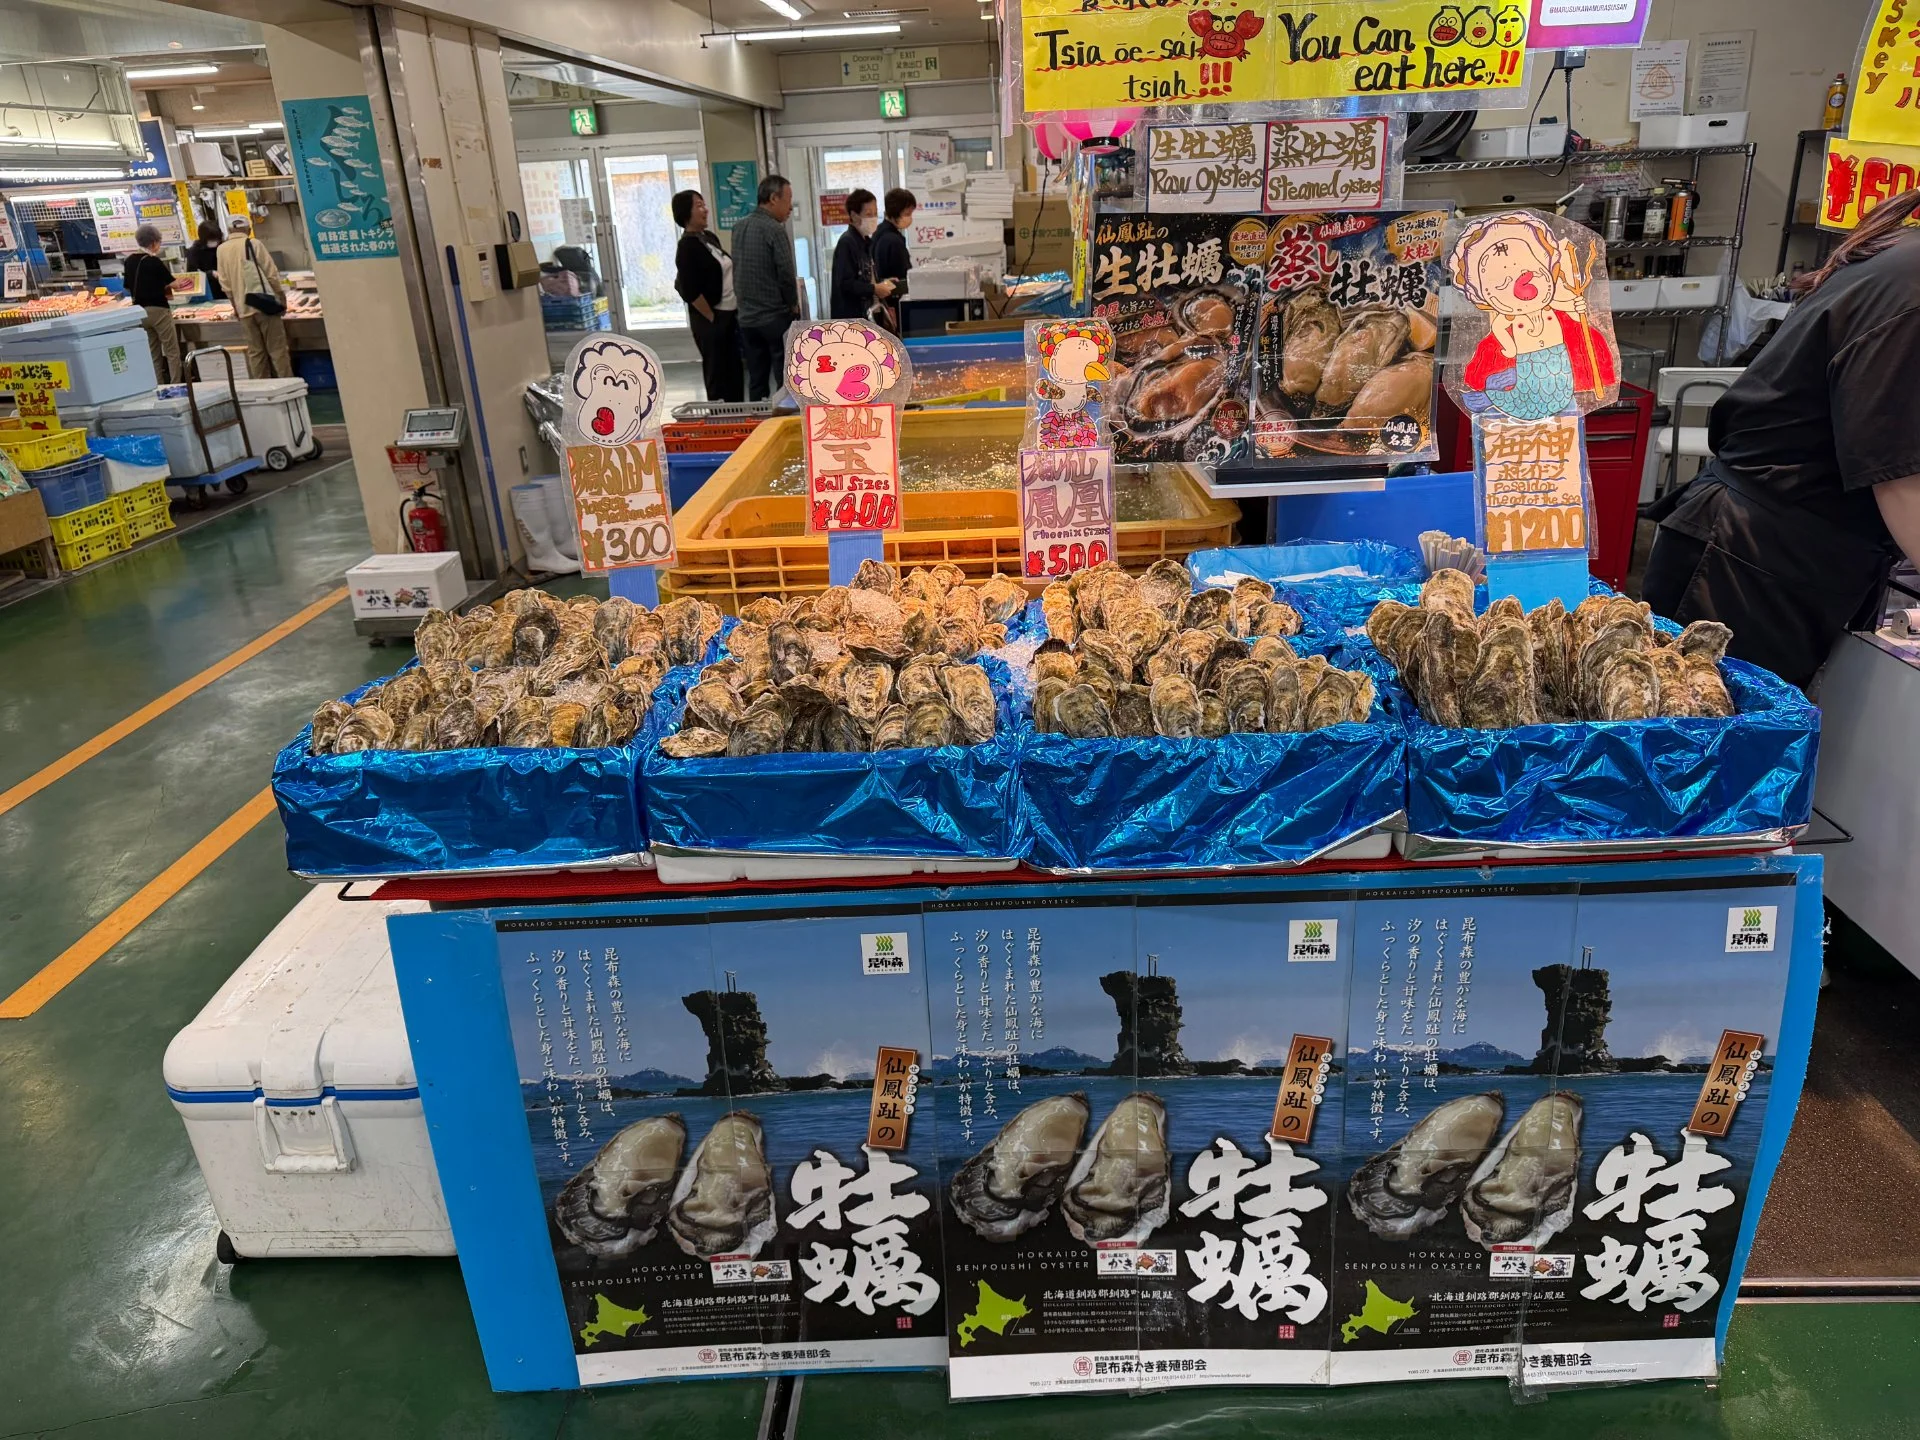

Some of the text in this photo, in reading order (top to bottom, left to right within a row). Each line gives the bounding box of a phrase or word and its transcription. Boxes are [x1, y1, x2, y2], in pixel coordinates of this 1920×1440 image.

[1034, 29, 1106, 70] Tsia
[1278, 13, 1416, 62] You Can
[900, 51, 916, 59] EXIT
[1354, 55, 1416, 91] eat
[1152, 124, 1258, 164] 生牡蠣
[1270, 119, 1377, 170] 蒸牡蠣
[1152, 168, 1190, 196] Raw
[1269, 170, 1381, 200] Steamed oysters
[1096, 221, 1169, 245] 仙鳳趾の
[1231, 231, 1267, 242] 産地直送
[1319, 219, 1366, 238] 仙鳳趾の
[1396, 217, 1441, 233] 旨み凝縮!
[1266, 224, 1340, 291] 蒸し
[1402, 242, 1438, 260] 大粒!
[1093, 237, 1224, 301] 生牡蠣
[1329, 260, 1428, 308] 牡蠣
[1219, 420, 1240, 432] 名産
[1385, 422, 1419, 435] 仙鳳趾
[1390, 433, 1413, 447] 名産
[819, 442, 877, 476] 玉
[815, 476, 889, 492] Ball Sizes
[1494, 480, 1558, 493] Poseidon
[1561, 493, 1582, 504] Sea
[812, 492, 897, 530] ¥400
[581, 522, 671, 568] ¥300
[1033, 529, 1082, 540] Phoenix
[1486, 507, 1585, 554] ¥1200
[1027, 539, 1108, 576] ¥500
[367, 594, 391, 608] かき
[504, 920, 553, 928] HOKKAIDO
[558, 918, 610, 926] SENPOUSHI
[1293, 944, 1330, 955] 昆布森
[1731, 933, 1769, 944] 昆布森
[868, 957, 904, 968] 昆布森
[1451, 917, 1476, 1036] 昆布森の豊かな海に
[1027, 927, 1044, 1041] 昆布森の豊かな海に
[604, 947, 632, 1063] 昆布森の豊かな海に
[1001, 929, 1023, 1097] はぐくまれた仙鳳趾の牡蠣は、
[1395, 918, 1423, 1120] 汐の香りと甘味をたっぷりと含み、
[1423, 918, 1449, 1095] はぐくまれた仙鳳趾の牡蠣は、
[578, 949, 616, 1118] はぐくまれた仙鳳趾の牡蠣は、
[950, 931, 976, 1148] ふっくらとした身と味わいが特徴です。
[975, 929, 999, 1121] 汐の香りと甘味をたっぷりと含み、
[1369, 921, 1397, 1145] ふっくらとした身と味わいが特徴です。
[526, 952, 574, 1169] ふっくらとした身と味わいが特徴です。
[551, 949, 595, 1144] 汐の香りと甘味をたっぷりと含み、
[876, 1055, 908, 1141] 仙鳳趾の
[1281, 1043, 1320, 1133] 仙鳳趾の
[1701, 1039, 1749, 1127] 仙鳳趾の
[786, 1143, 940, 1315] 牡蠣
[1178, 1133, 1328, 1325] 牡蠣
[1579, 1132, 1736, 1312] 牡蠣
[631, 1263, 703, 1274] HOKKAIDO
[956, 1261, 1089, 1271] SENPOUSHI OYSTER
[1017, 1250, 1089, 1260] HOKKAIDO
[1108, 1258, 1133, 1270] かき
[1344, 1262, 1482, 1271] SENPOUSHI OYSTER
[1408, 1251, 1482, 1260] HOKKAIDO
[1501, 1261, 1527, 1273] かき
[571, 1272, 705, 1288] SENPOUSHI OYSTER
[723, 1268, 747, 1279] かき
[719, 1349, 831, 1362] 昆布森かき養殖部会
[1095, 1359, 1208, 1375] 昆布森かき養殖部会
[1474, 1352, 1592, 1368] 昆布森かき養殖部会
